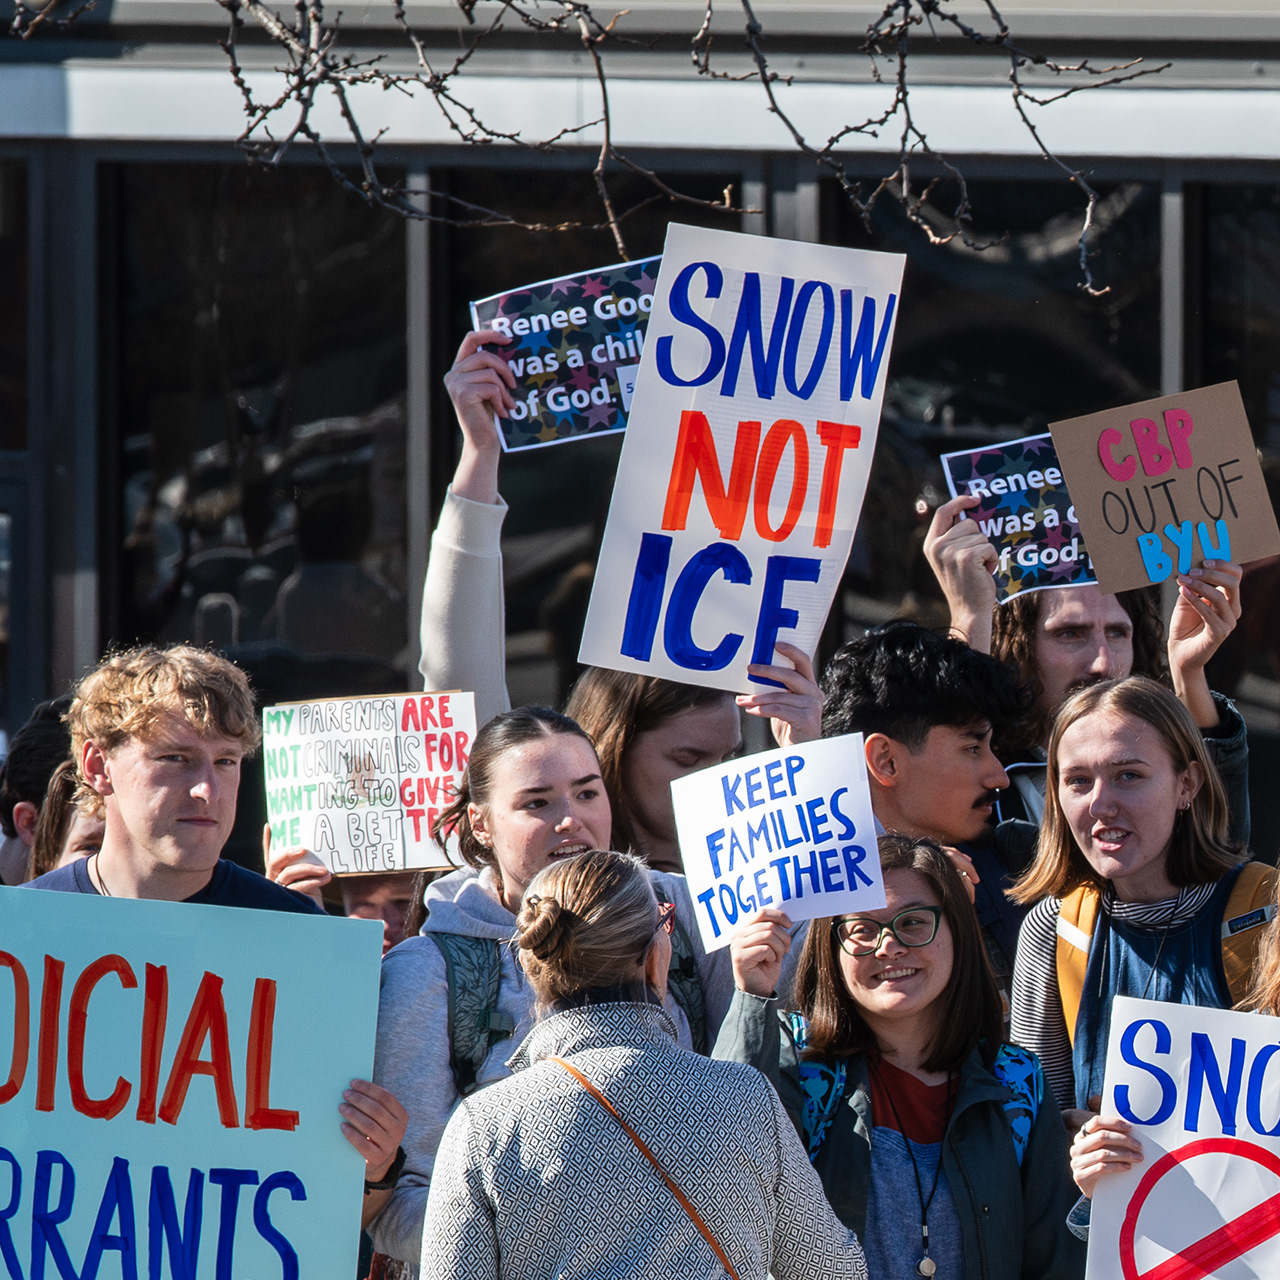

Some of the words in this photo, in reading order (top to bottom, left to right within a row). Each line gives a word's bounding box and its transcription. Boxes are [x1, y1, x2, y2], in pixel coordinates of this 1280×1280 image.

[492, 306, 588, 338] Renee
[656, 261, 897, 402] SNOW
[565, 348, 585, 369] a
[510, 389, 539, 421] of
[546, 378, 617, 412] God.
[1098, 408, 1194, 482] CBP
[661, 410, 861, 548] NOT
[967, 467, 1062, 498] Renee
[1102, 478, 1181, 535] OUT
[1197, 458, 1244, 522] OF
[979, 507, 1036, 538] was
[1043, 508, 1060, 528] a
[1017, 538, 1085, 567] God.
[1137, 520, 1232, 583] BYU
[620, 532, 822, 689] ICE
[265, 709, 295, 737] MY
[299, 698, 397, 736] PARENTS
[401, 695, 454, 733] ARE
[266, 745, 301, 782] NOT
[303, 734, 421, 780] CRIMINALS
[424, 731, 469, 772] FOR
[267, 779, 359, 816] WANTING
[364, 778, 397, 807] TO
[400, 775, 455, 808] GIVE
[721, 755, 805, 817] KEEP
[270, 817, 301, 851] ME
[314, 813, 335, 852] A
[706, 787, 856, 879] FAMILIES
[330, 843, 396, 874] LIFE
[697, 845, 874, 938] TOGETHER
